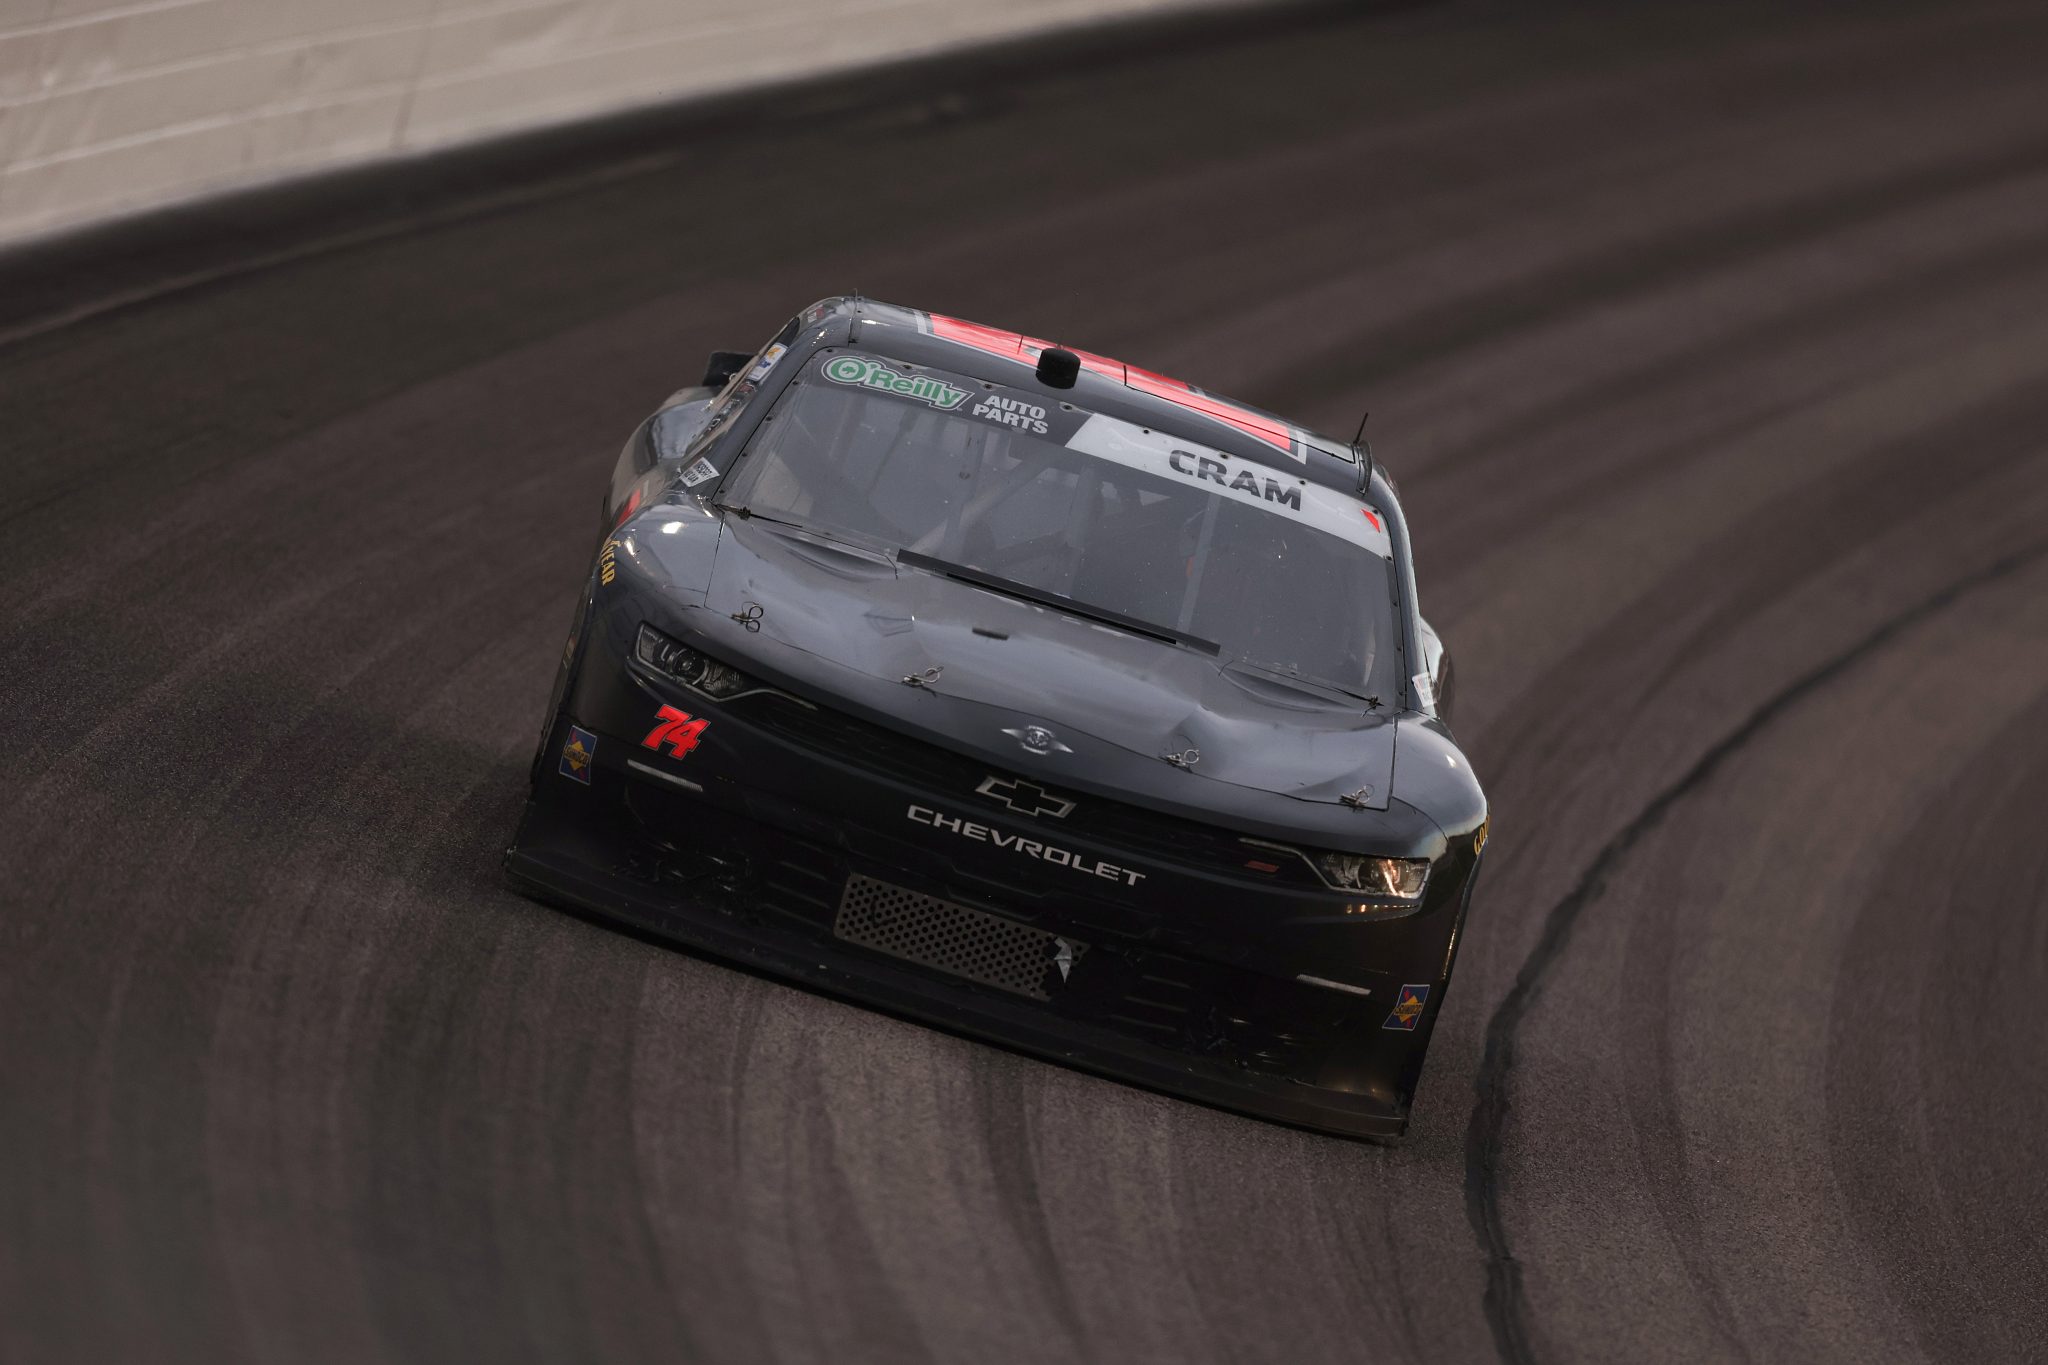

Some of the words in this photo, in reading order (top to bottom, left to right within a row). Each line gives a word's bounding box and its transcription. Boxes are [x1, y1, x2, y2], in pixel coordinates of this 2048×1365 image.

[828, 357, 964, 408] O'Reilly
[983, 395, 1046, 420] AUTO
[972, 403, 1048, 434] PARTS
[1169, 449, 1301, 511] CRAM
[641, 703, 711, 760] 74
[907, 804, 1146, 886] CHEVROLET
